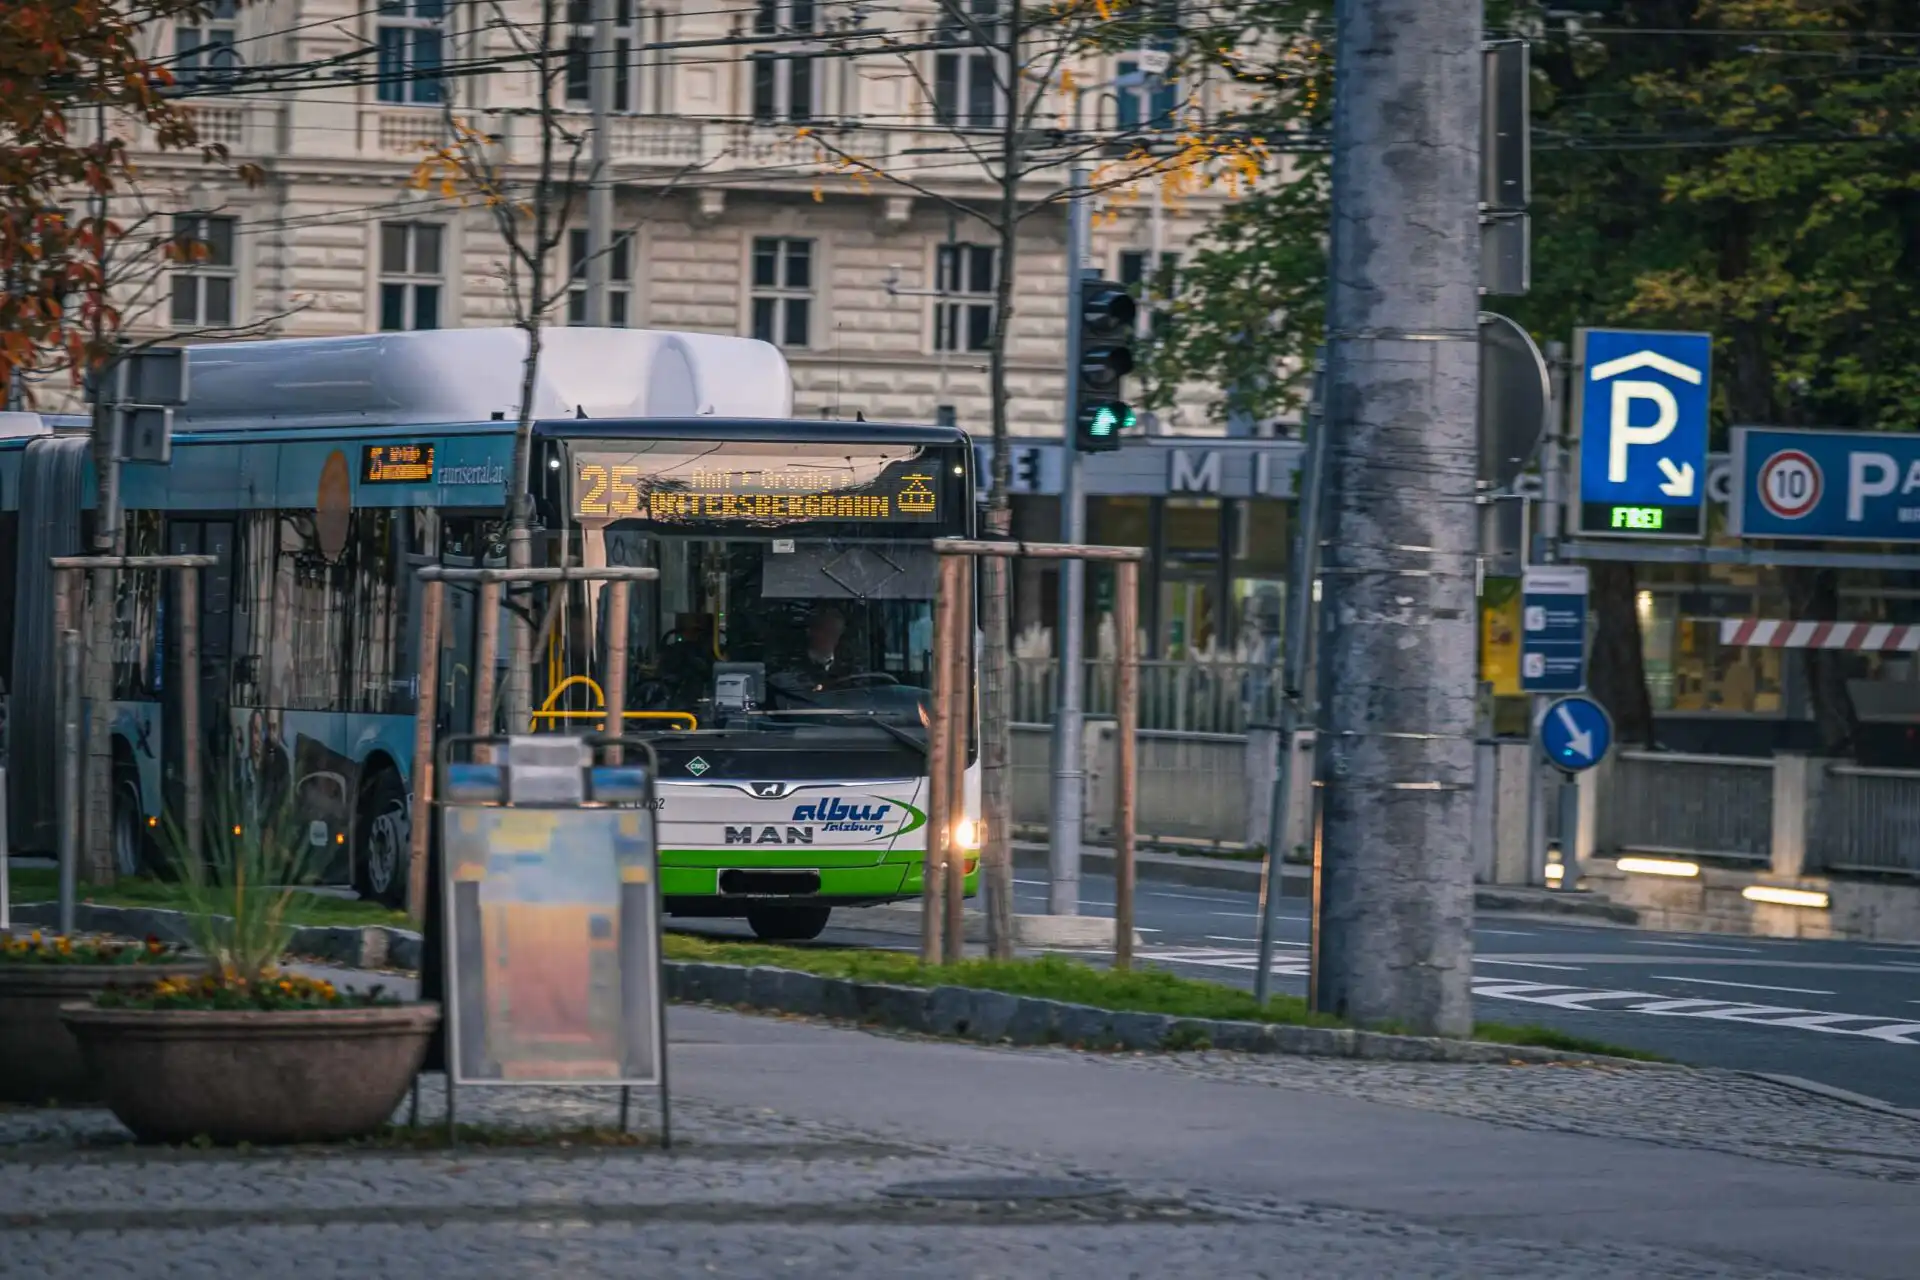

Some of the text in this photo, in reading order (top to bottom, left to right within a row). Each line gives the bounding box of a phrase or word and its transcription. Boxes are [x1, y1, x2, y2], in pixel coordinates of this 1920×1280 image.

[1608, 380, 1679, 483] P
[580, 465, 639, 514] 25
[1776, 470, 1806, 499] 10
[650, 492, 889, 517] UNTERSBERGBAHN
[792, 797, 892, 821] albus
[725, 826, 814, 844] MAN
[821, 822, 884, 835] Salzburg
